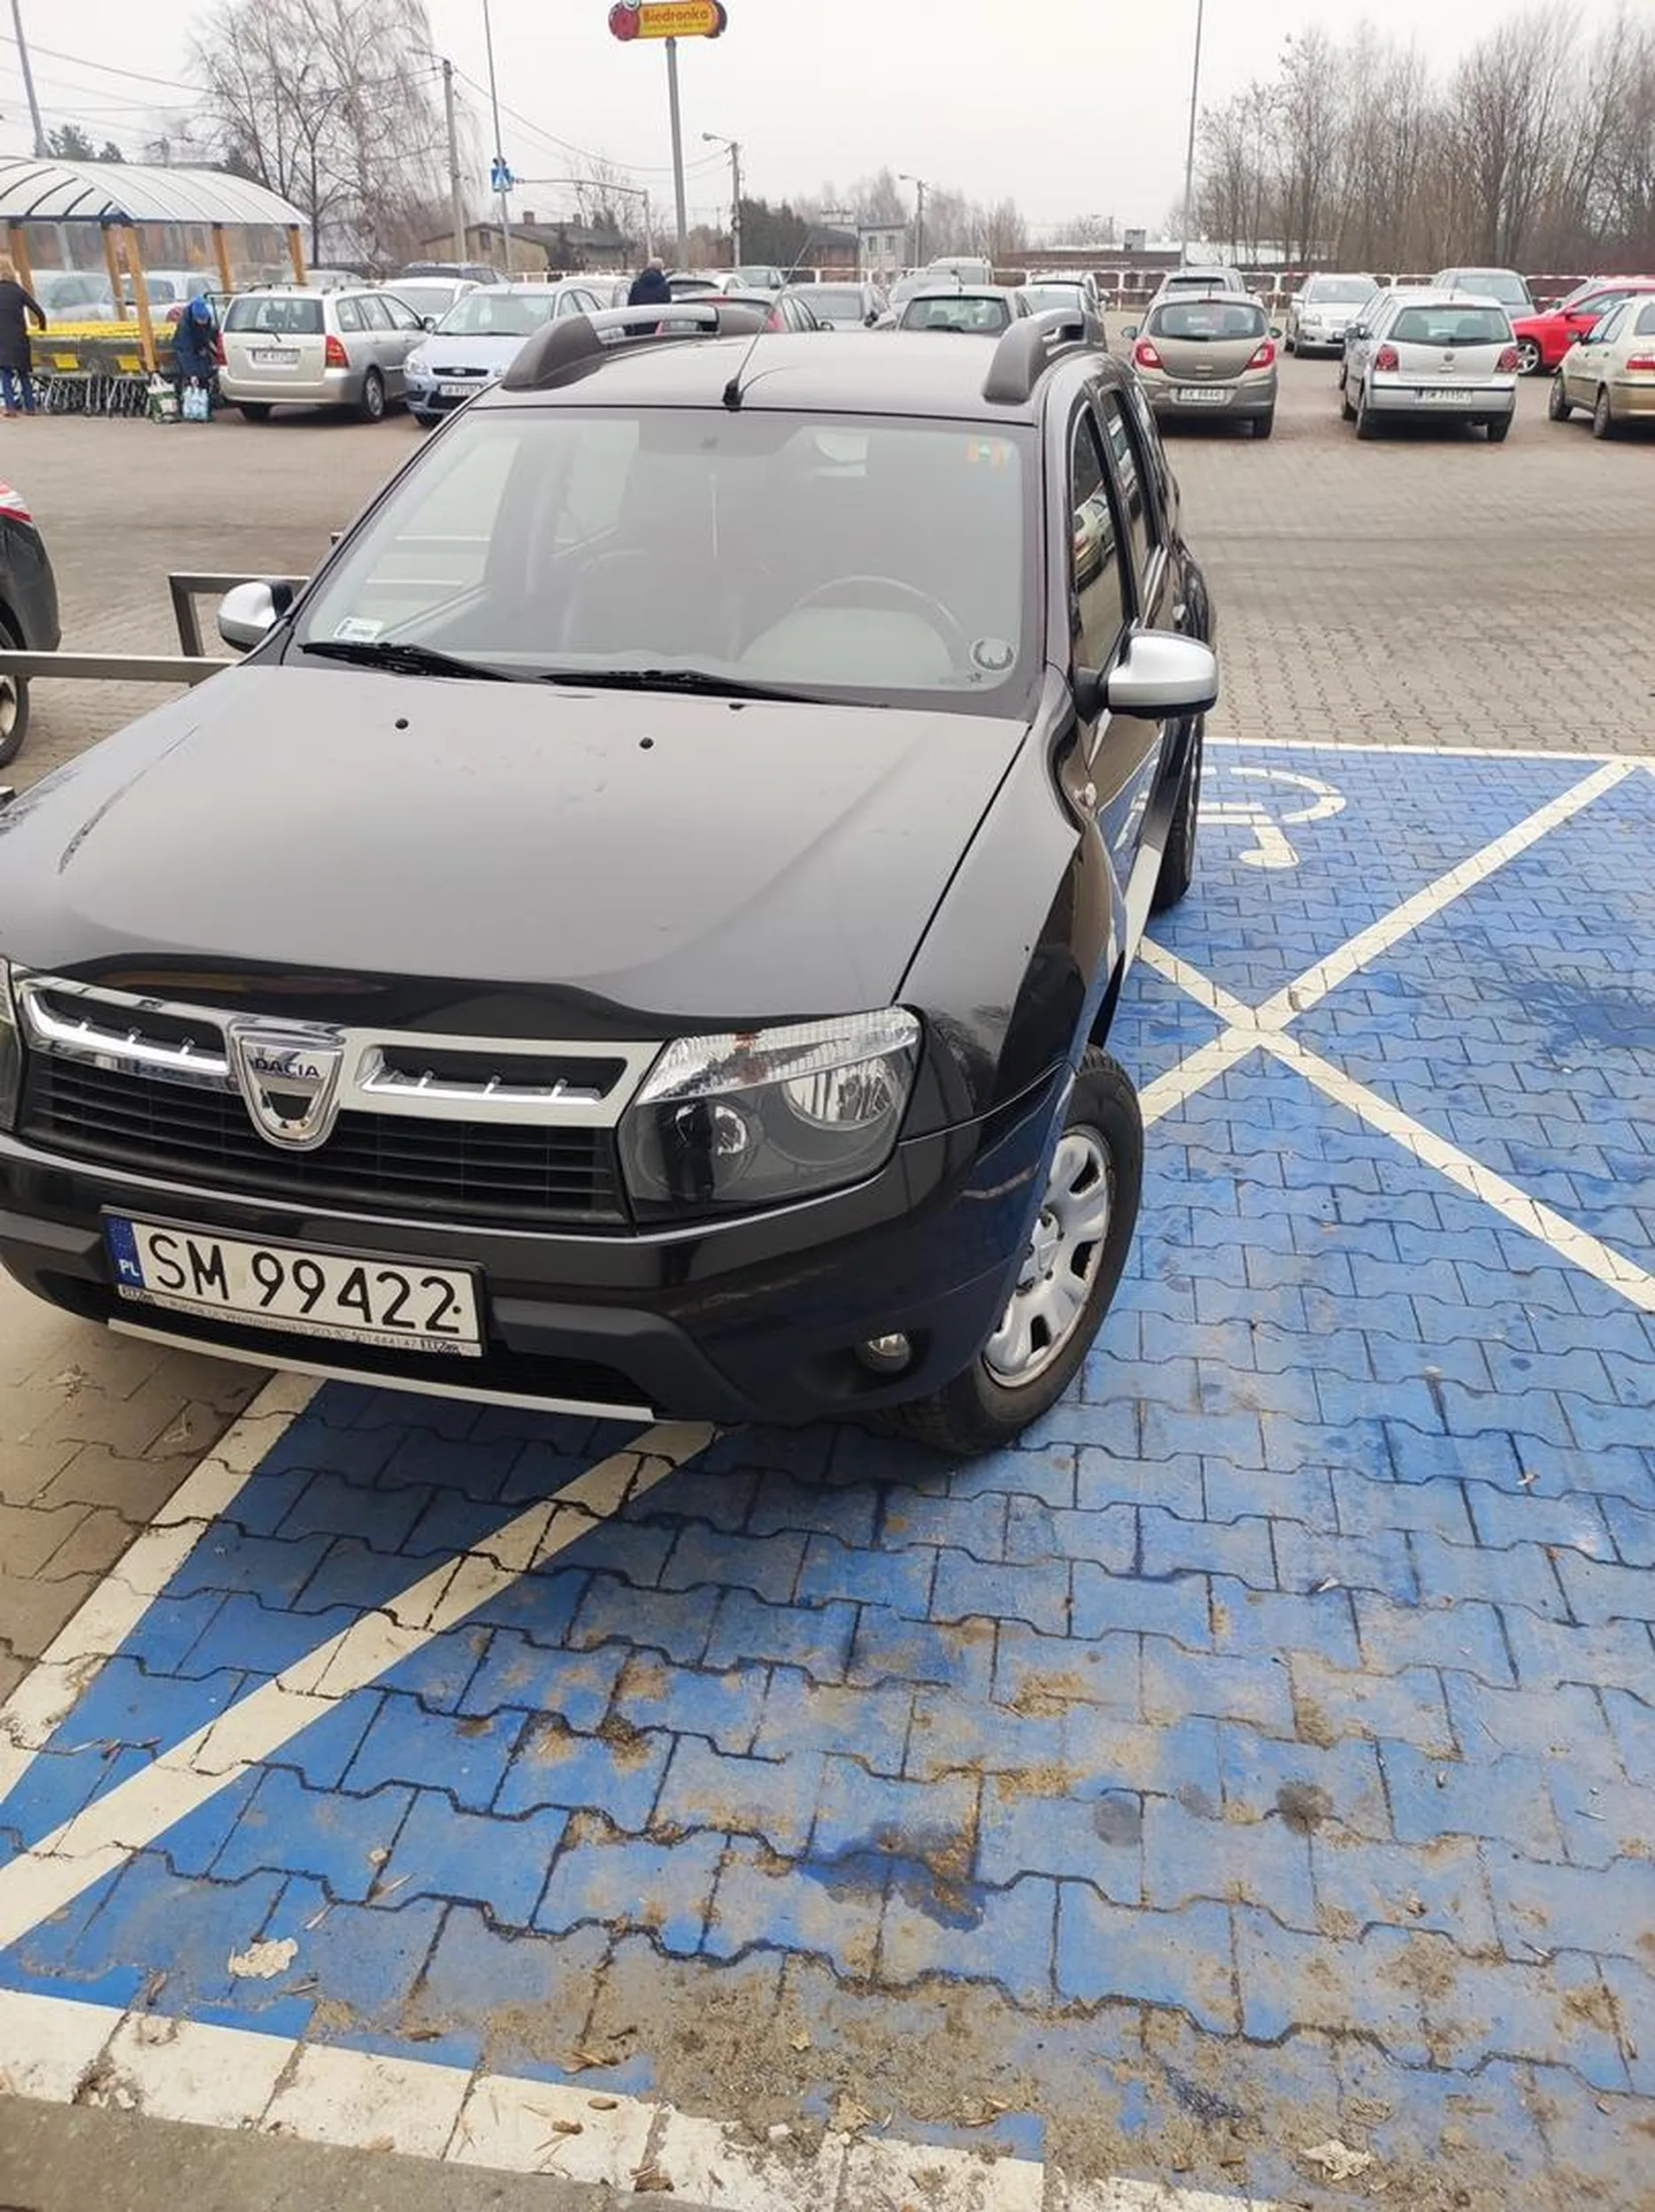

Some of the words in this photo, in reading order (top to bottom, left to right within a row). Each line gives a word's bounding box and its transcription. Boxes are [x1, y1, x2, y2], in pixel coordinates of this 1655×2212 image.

[255, 1058, 319, 1077] DACIA
[119, 1259, 140, 1277] PL
[149, 1233, 229, 1300] SM
[251, 1251, 459, 1334] 99422
